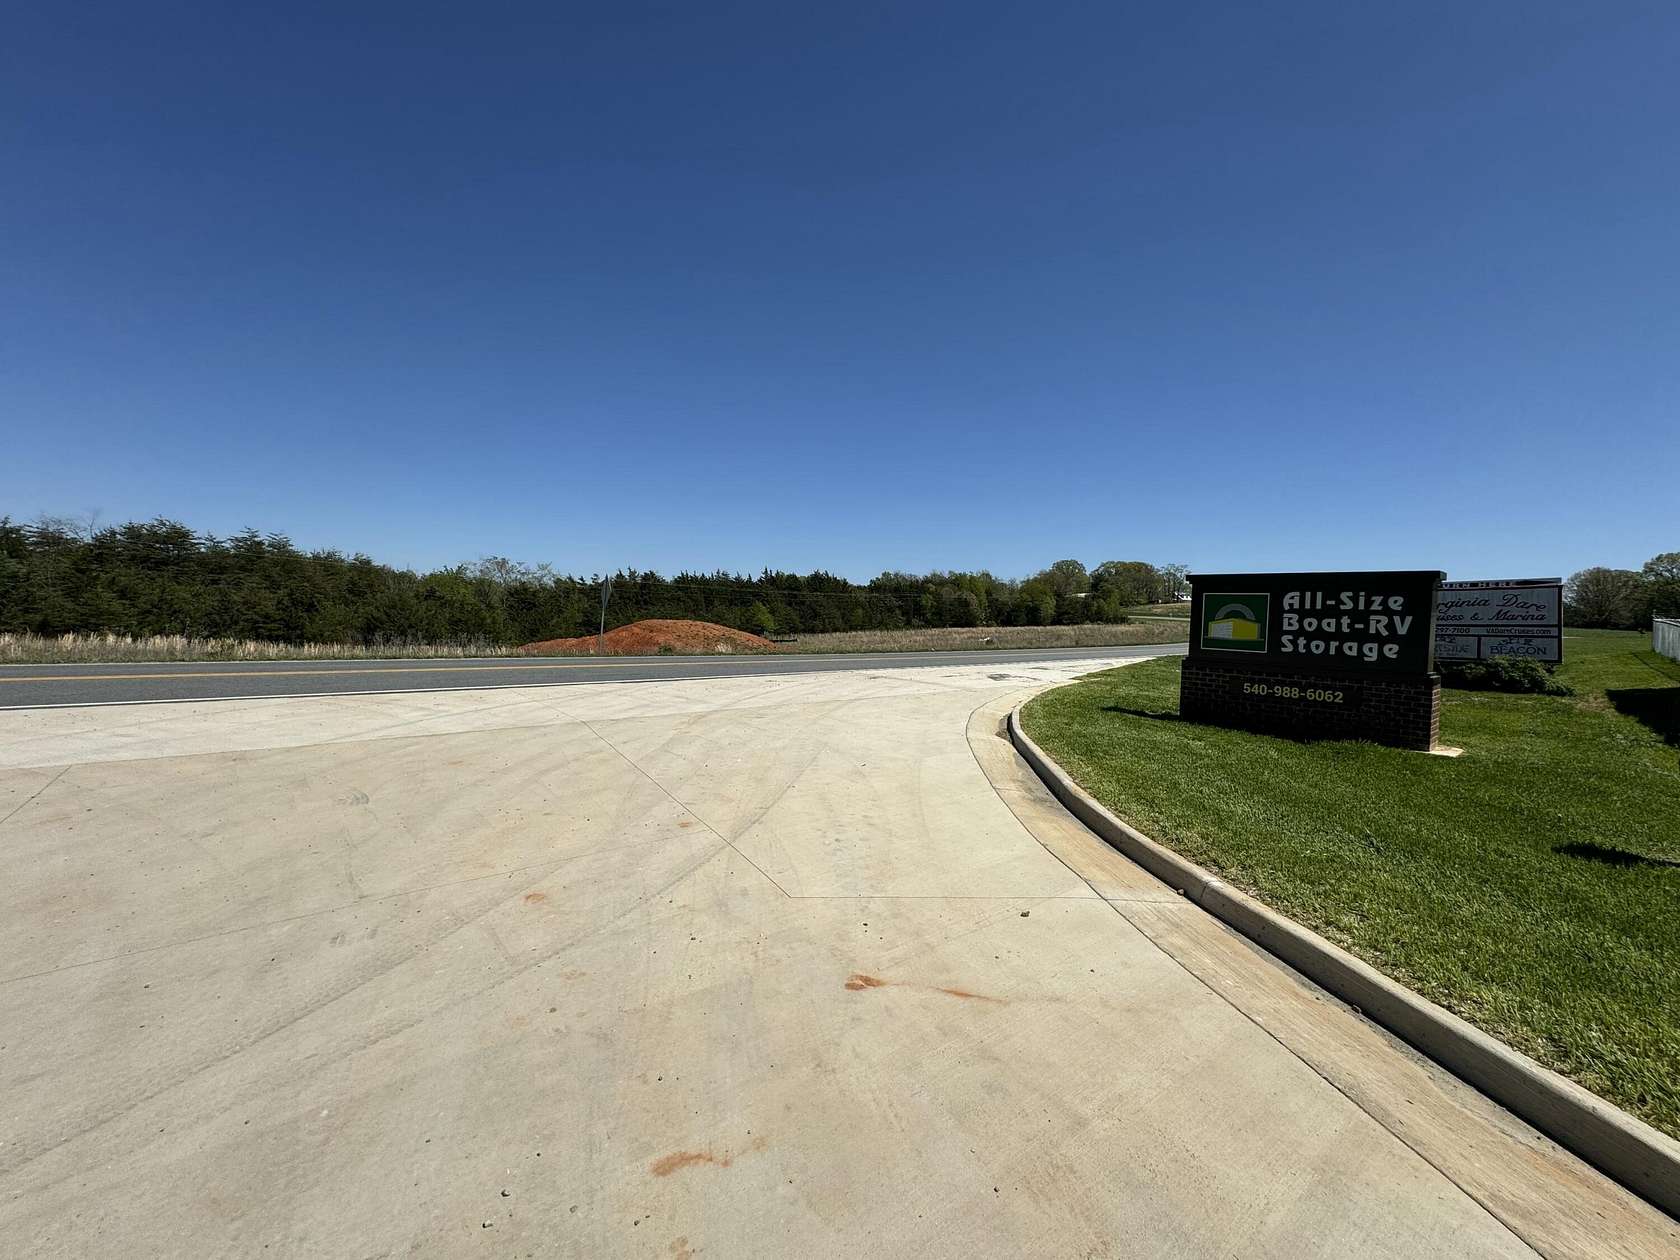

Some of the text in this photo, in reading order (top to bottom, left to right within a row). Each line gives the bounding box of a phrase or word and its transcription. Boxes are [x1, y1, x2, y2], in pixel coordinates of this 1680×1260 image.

[1282, 591, 1405, 611] All-Size
[1436, 593, 1546, 614] rginia Dare
[1281, 613, 1413, 636] Boat-RV
[1487, 608, 1547, 621] Marina
[1280, 635, 1400, 661] Storage
[1489, 645, 1547, 655] BEACON
[1243, 682, 1344, 703] 540-988-6062
